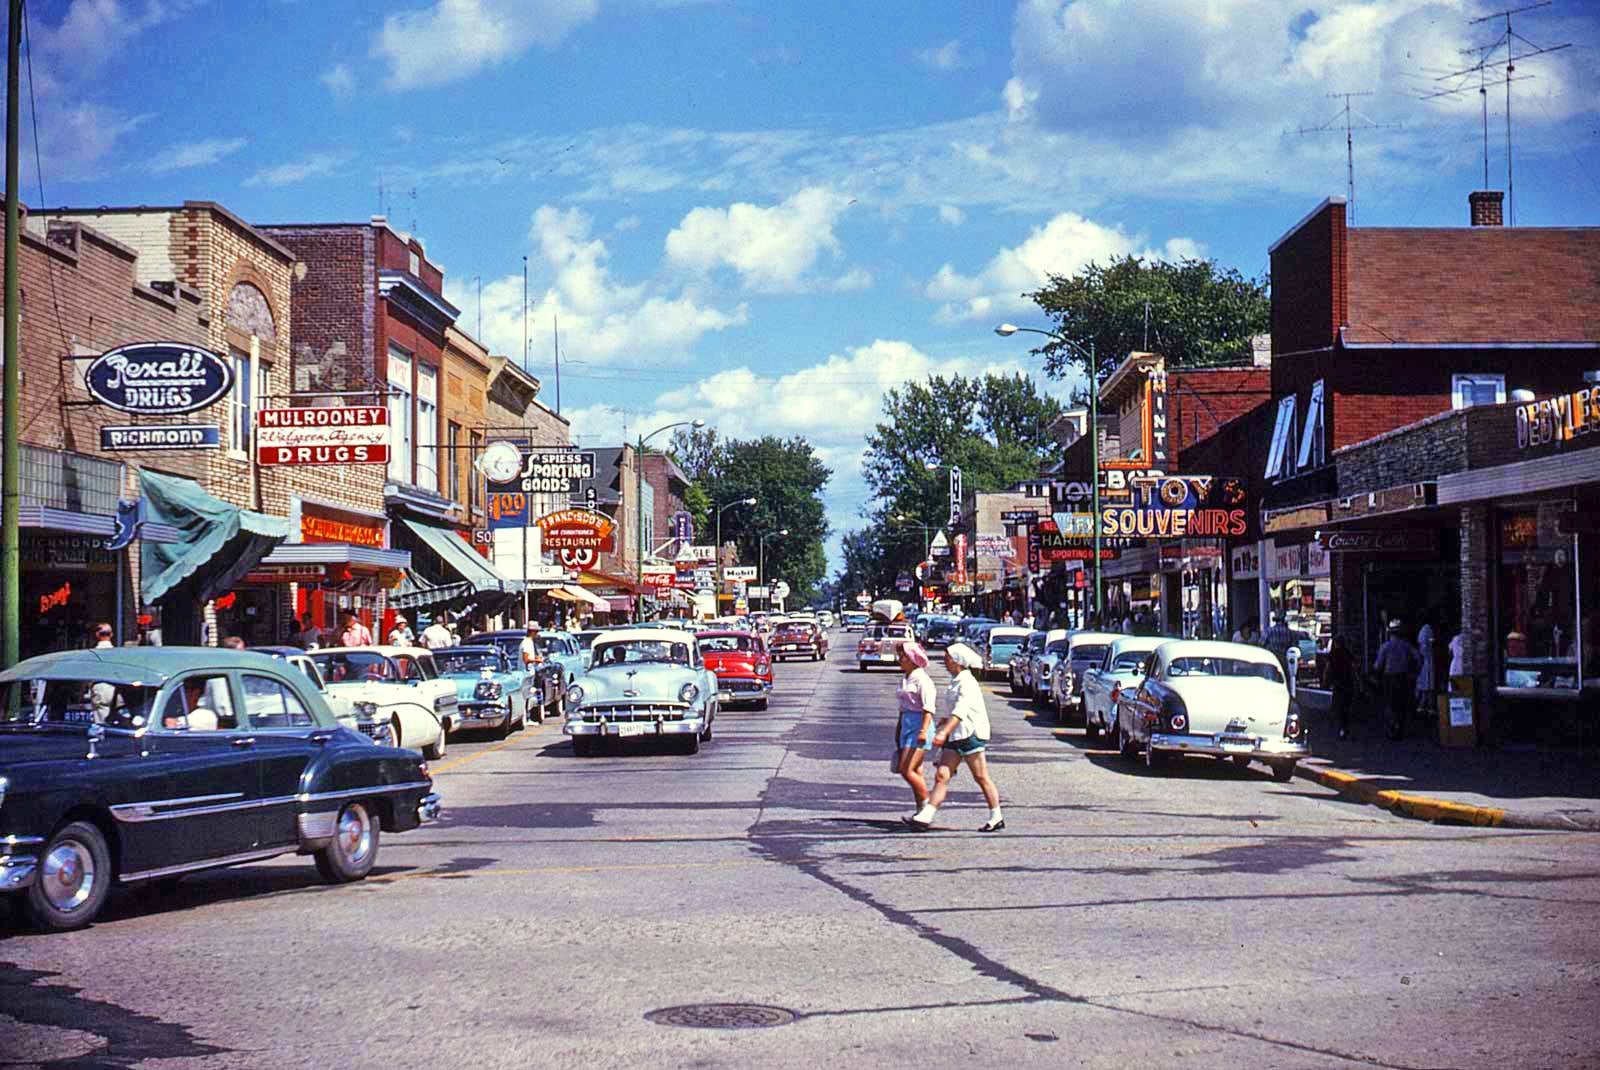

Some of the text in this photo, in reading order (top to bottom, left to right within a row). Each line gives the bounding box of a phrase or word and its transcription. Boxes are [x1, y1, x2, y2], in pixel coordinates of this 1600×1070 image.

[106, 353, 206, 388] Rexall
[125, 387, 192, 407] DRUGS
[264, 409, 380, 426] MULROONEY
[110, 430, 203, 445] RICHMOND
[278, 447, 368, 463] DRUGS
[541, 454, 582, 464] SPIESS
[520, 454, 592, 478] SPORTING
[521, 478, 571, 493] GOODS
[541, 510, 605, 529] FRANCISCO'S
[1102, 508, 1248, 536] SOUVENIRS
[544, 537, 602, 547] RESTAURANT
[1051, 549, 1115, 558] SPORTING GODS
[726, 569, 755, 578] Mobil
